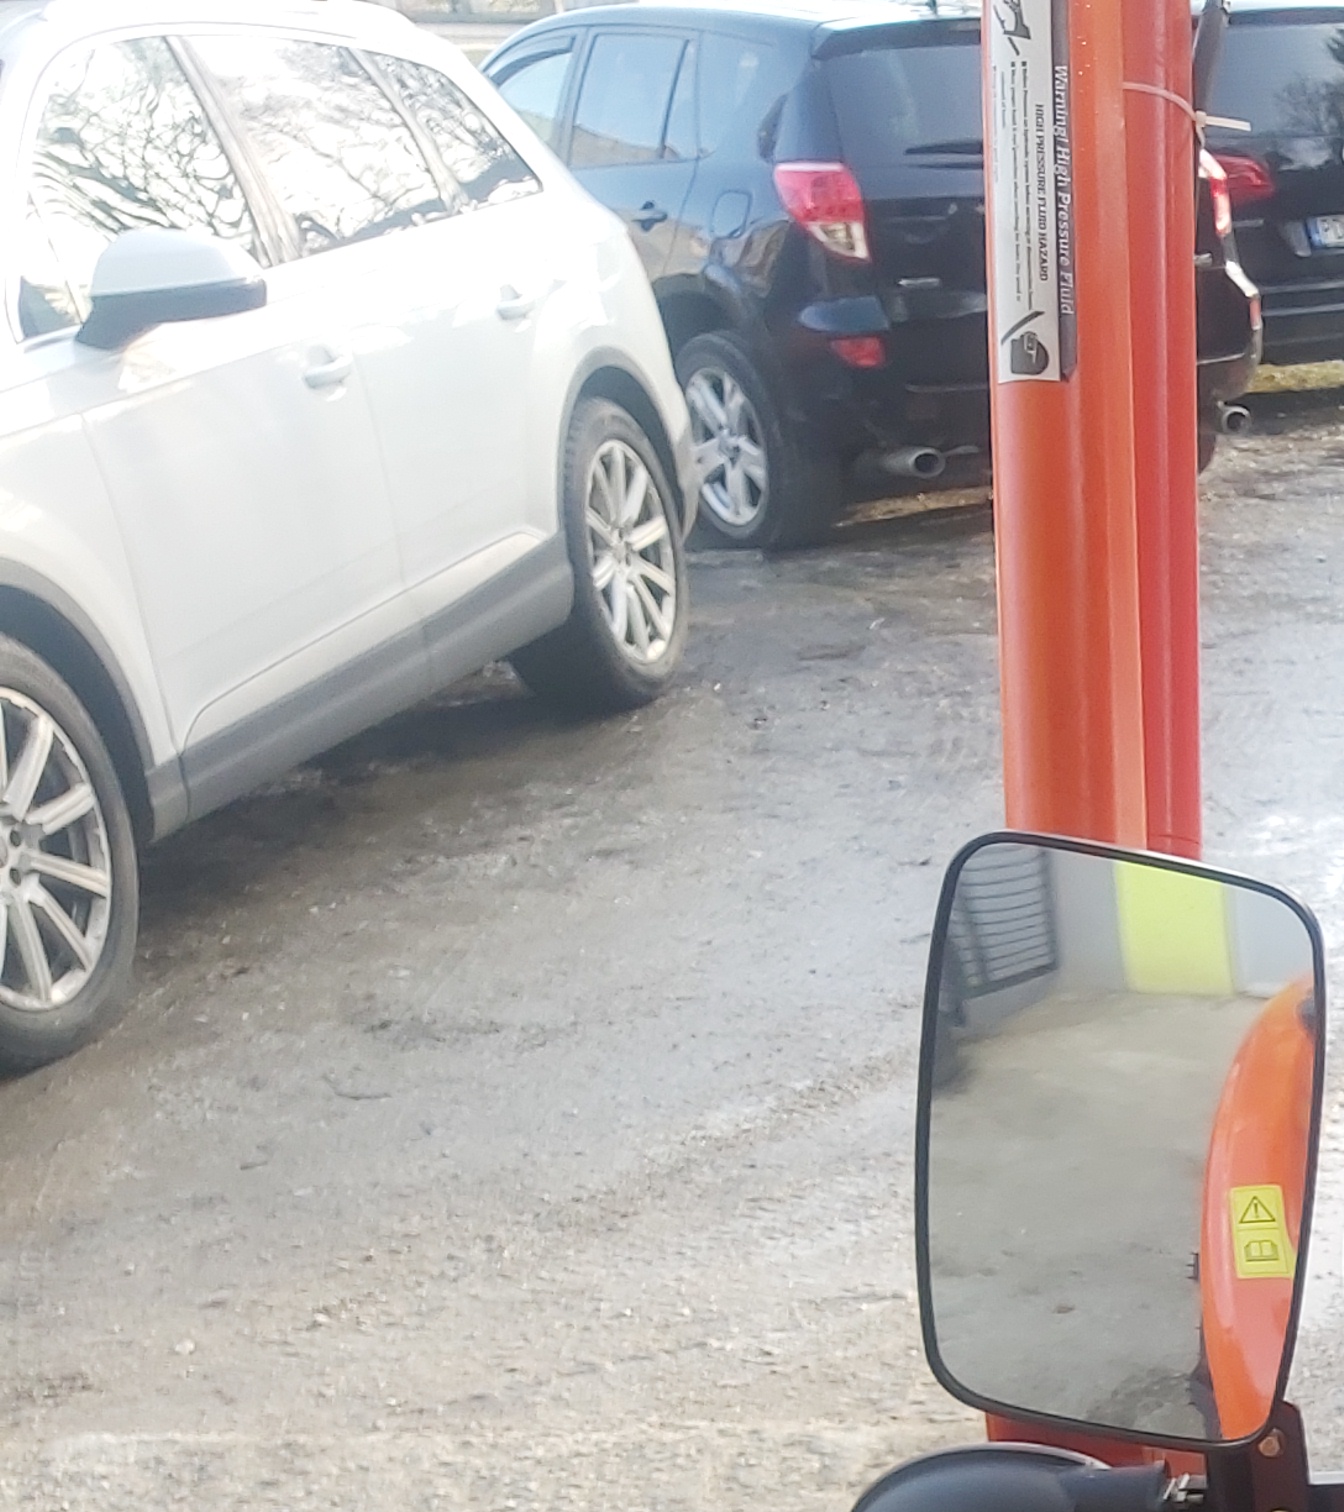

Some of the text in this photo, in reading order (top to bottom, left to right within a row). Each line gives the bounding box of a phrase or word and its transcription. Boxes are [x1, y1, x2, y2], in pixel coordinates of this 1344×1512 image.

[1035, 104, 1049, 281] HIGH PRESSURE FLUID HAZARD
[1053, 65, 1075, 315] Warning! High Pressure Fluid
